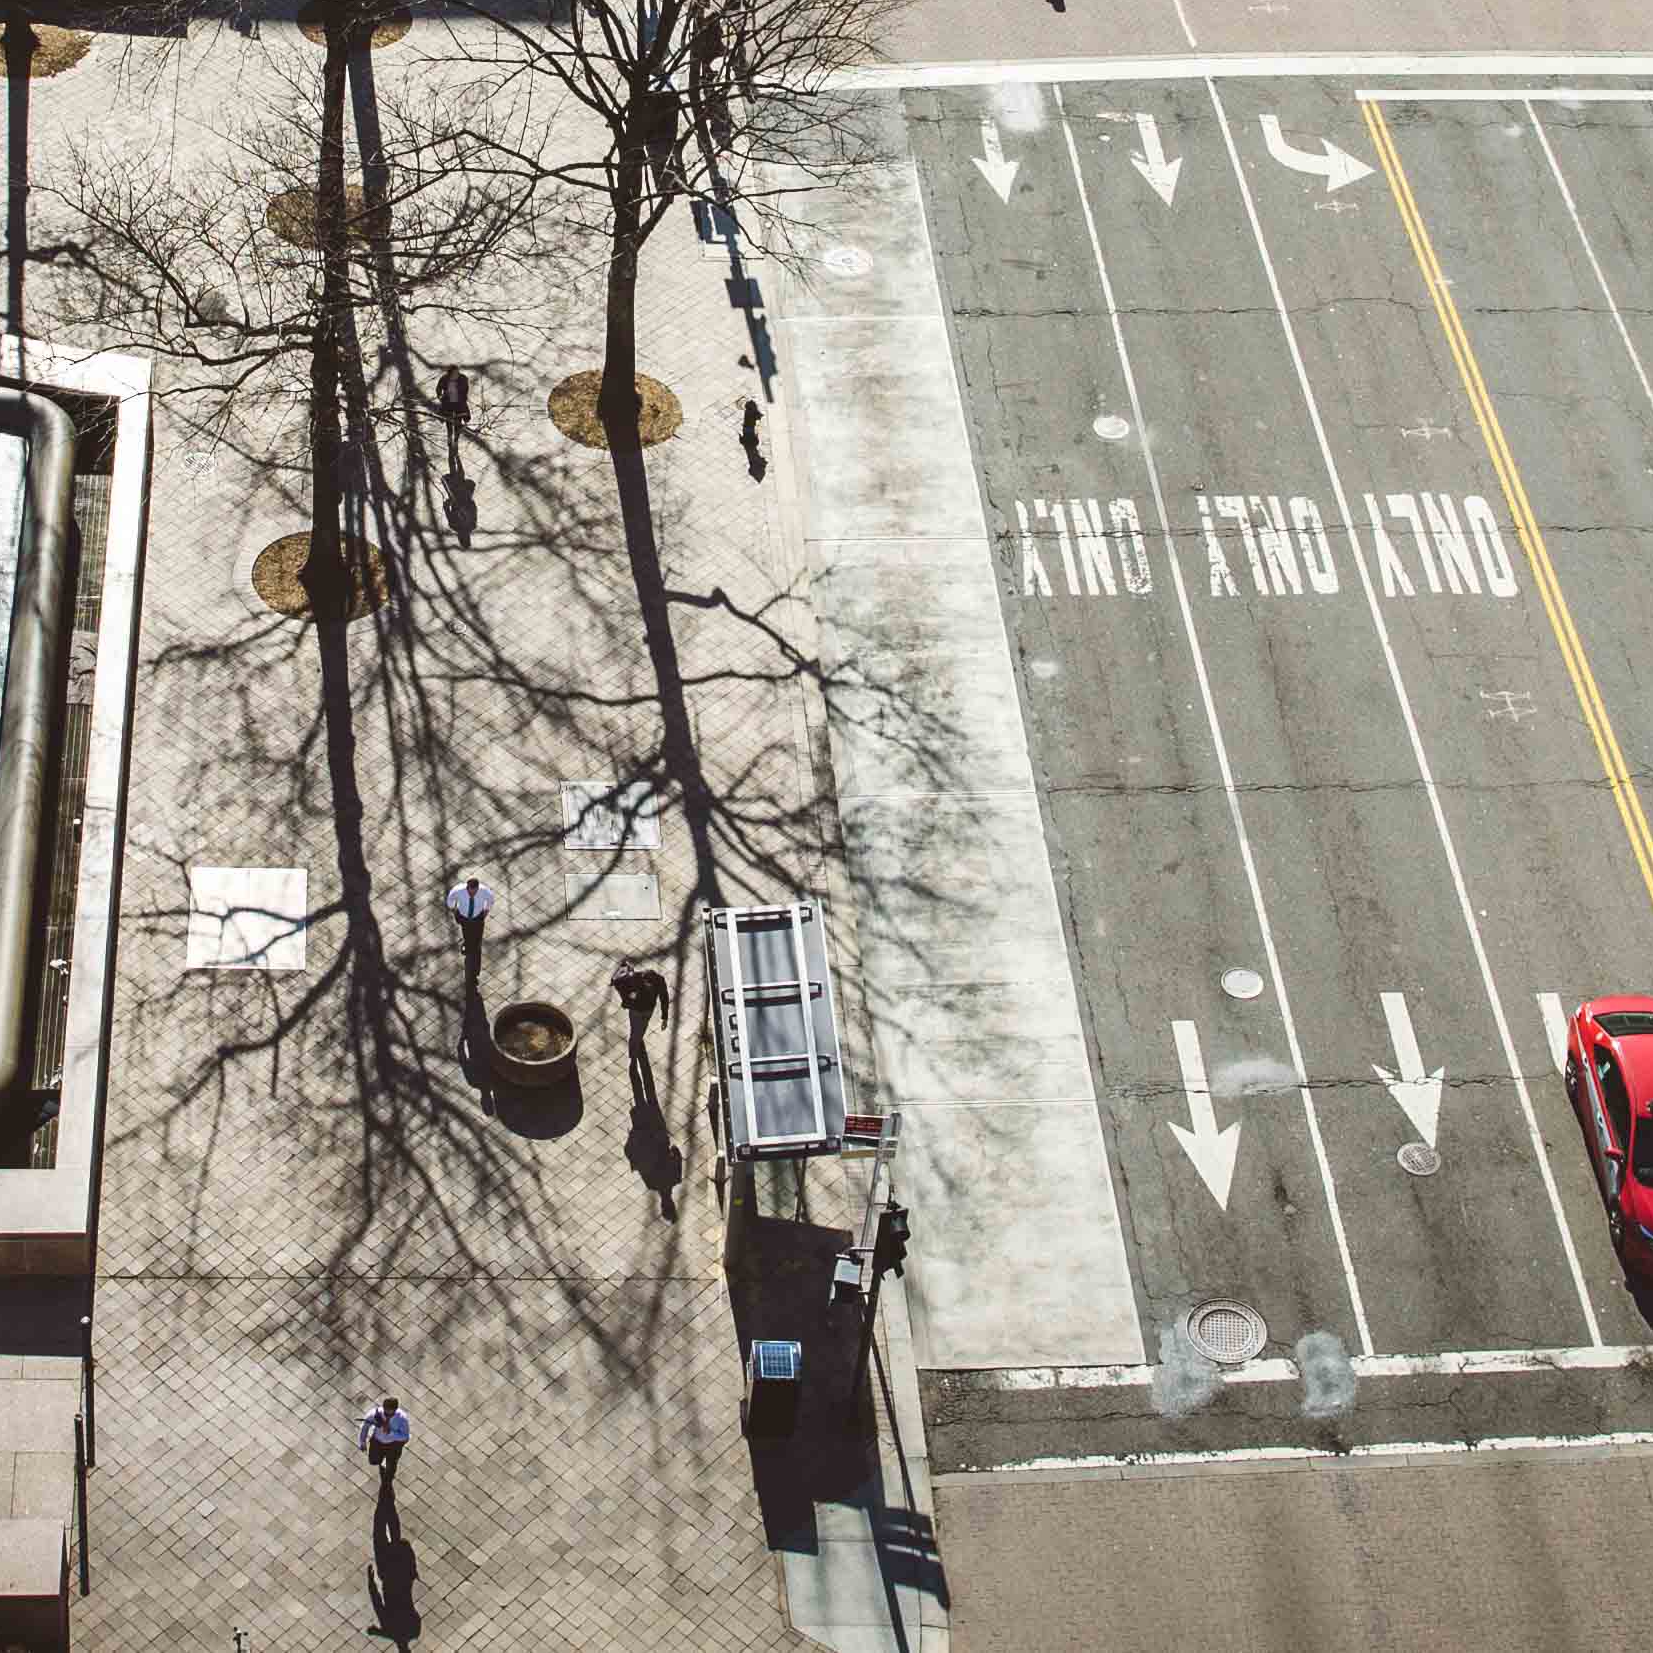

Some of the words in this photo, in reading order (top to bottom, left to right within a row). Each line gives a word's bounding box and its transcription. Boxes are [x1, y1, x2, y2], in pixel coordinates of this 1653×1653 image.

[1014, 497, 1154, 598] ONLY
[1195, 495, 1340, 597] ONLY
[1364, 493, 1518, 598] ONLY
